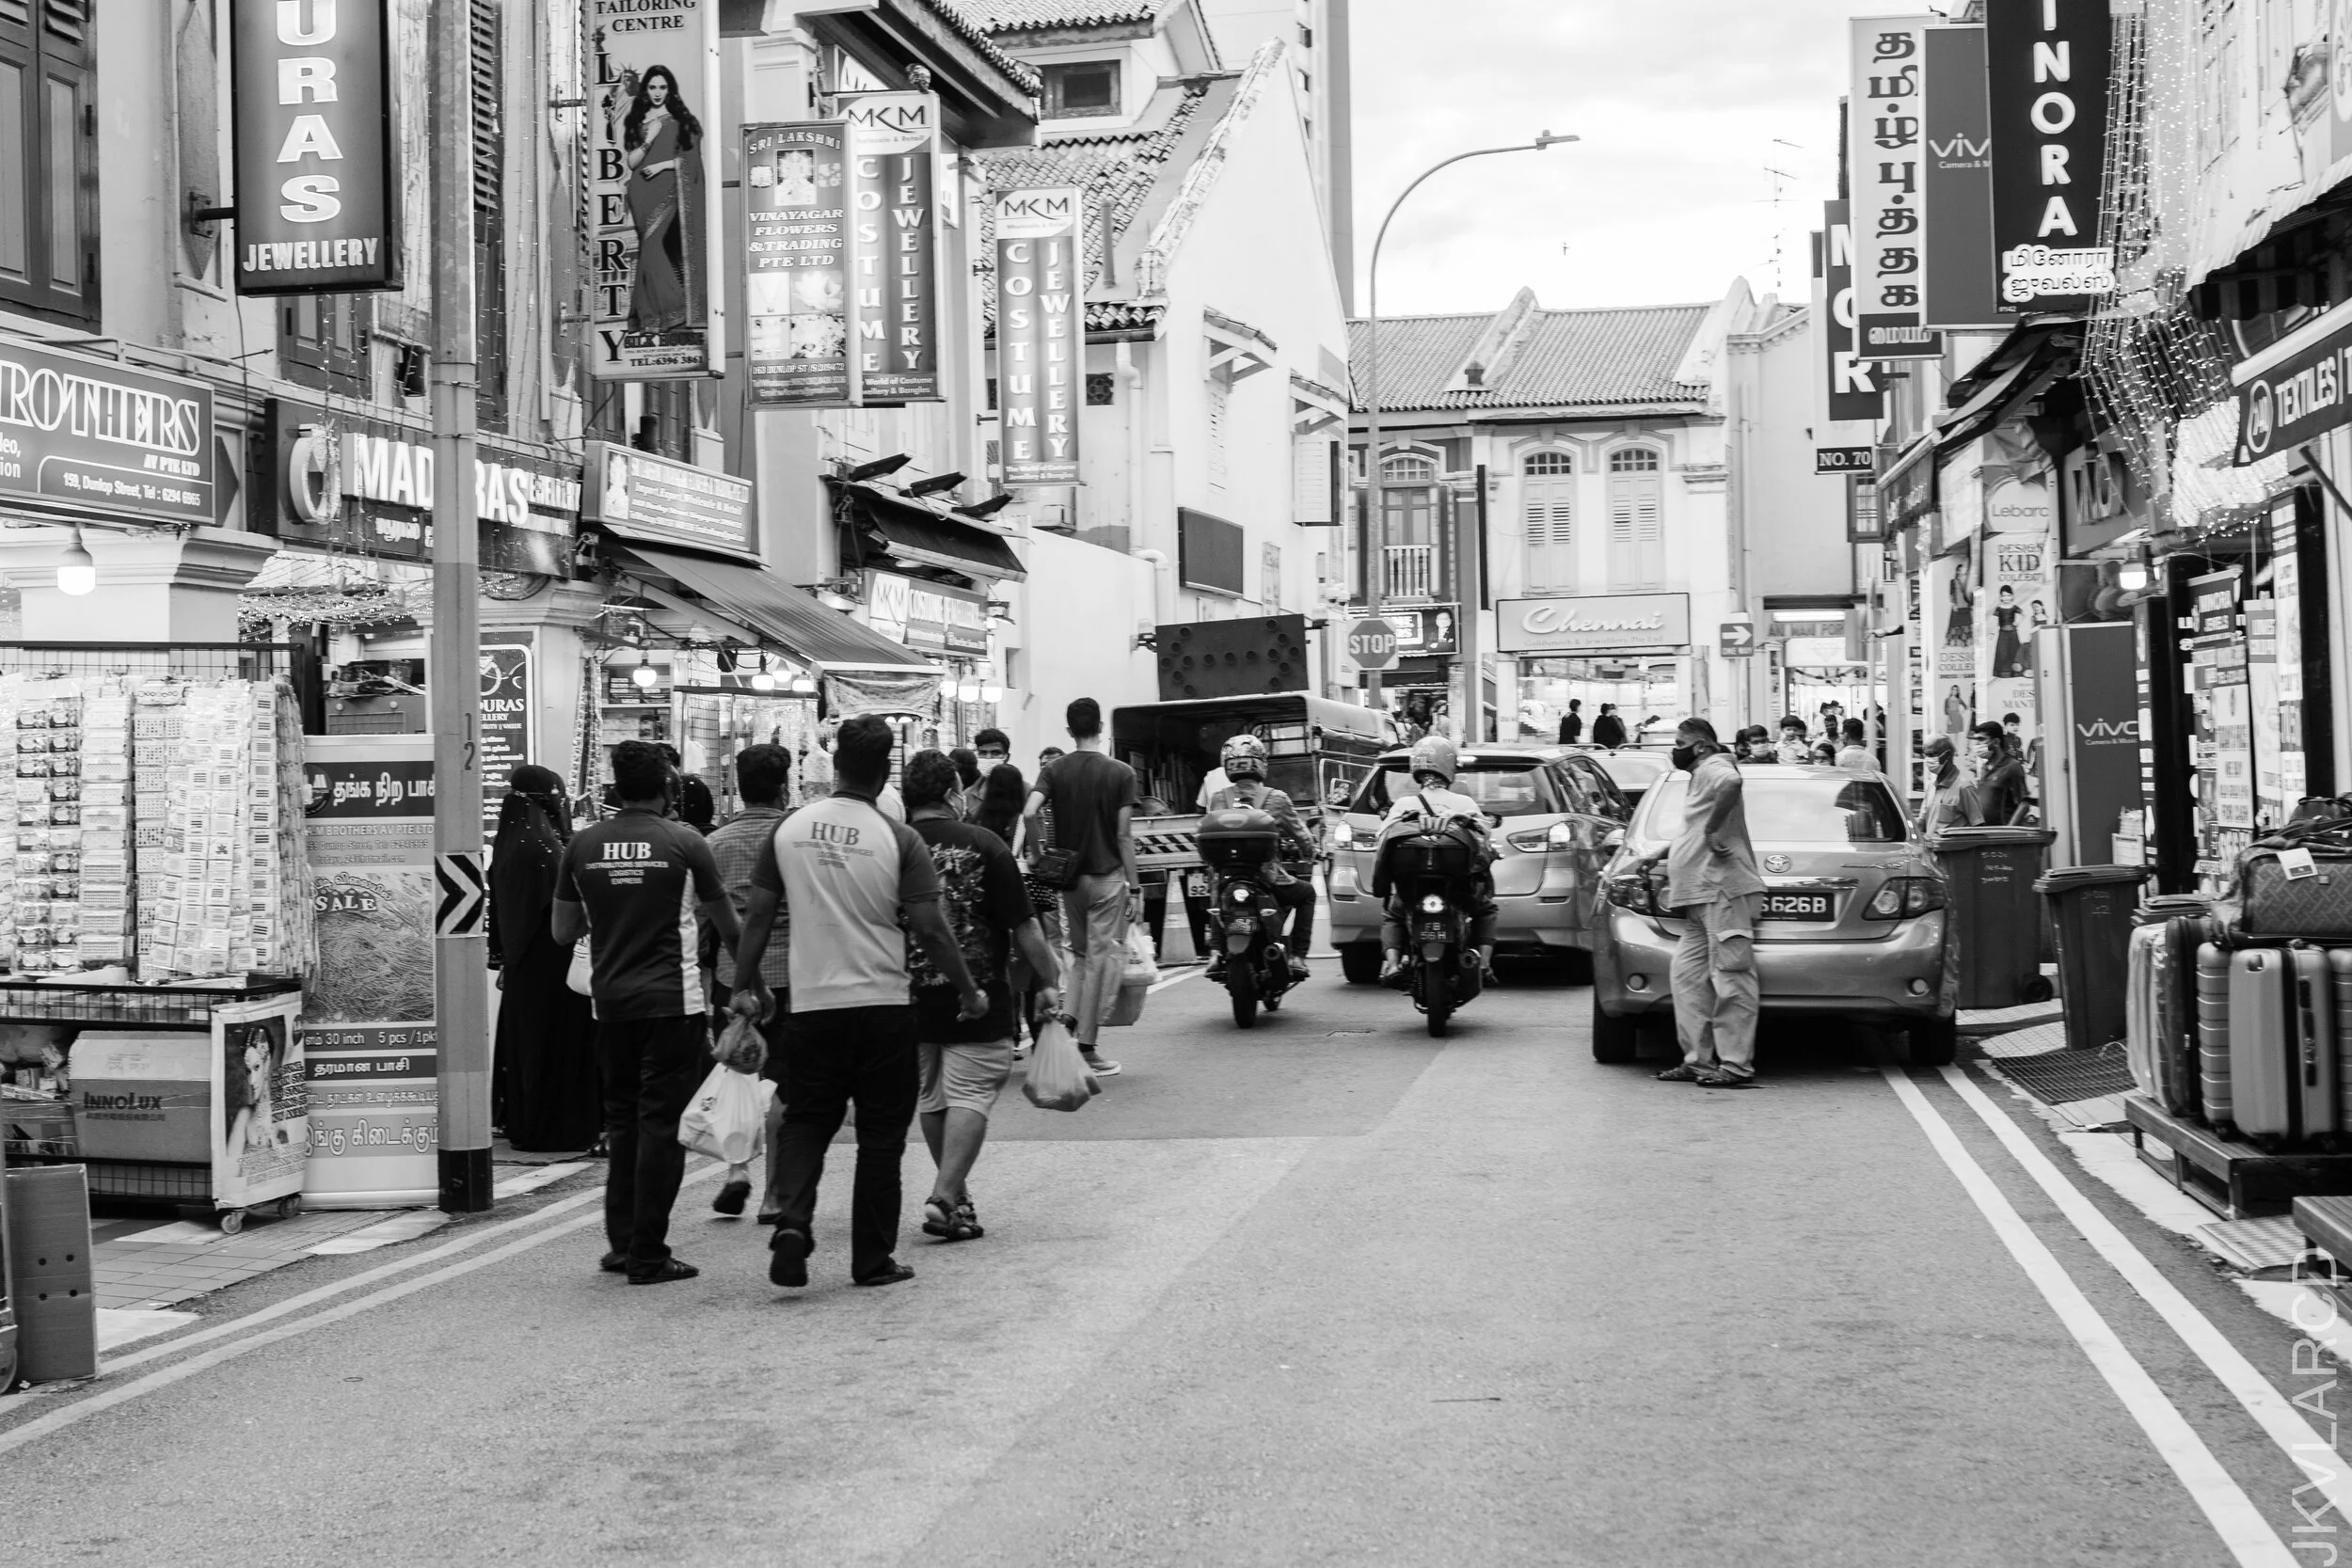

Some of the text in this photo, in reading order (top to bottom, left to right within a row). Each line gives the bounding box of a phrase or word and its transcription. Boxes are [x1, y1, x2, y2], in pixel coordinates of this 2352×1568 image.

[595, 0, 697, 14] TAILORING
[612, 15, 685, 33] CENTRE
[277, 0, 343, 223] URAS
[749, 132, 841, 154] SRI LAKSHMI
[749, 209, 844, 222] VINAYAGAR
[754, 223, 838, 236] FLOWERS
[243, 237, 378, 272] JEWELLERY
[758, 255, 835, 268] PTE LTD
[892, 156, 925, 370] JEWELLERY
[857, 158, 886, 372] COSTUME
[1005, 243, 1037, 460] COSTUME
[1039, 242, 1072, 458] JEWELLERY
[2275, 356, 2338, 427] TEXTILES
[1818, 451, 1871, 467] NO. 70
[1521, 605, 1665, 634] Chennai
[1349, 633, 1396, 655] STOP
[1722, 646, 1753, 656] ONE WAY
[326, 825, 377, 836] BROTHERS
[415, 824, 434, 835] LTD
[810, 821, 860, 845] HUB
[602, 842, 652, 860] HUB
[315, 894, 377, 911] SALE
[326, 1032, 341, 1045] 30
[342, 1032, 365, 1045] inch
[377, 1031, 386, 1044] 5
[389, 1033, 407, 1046] pcs
